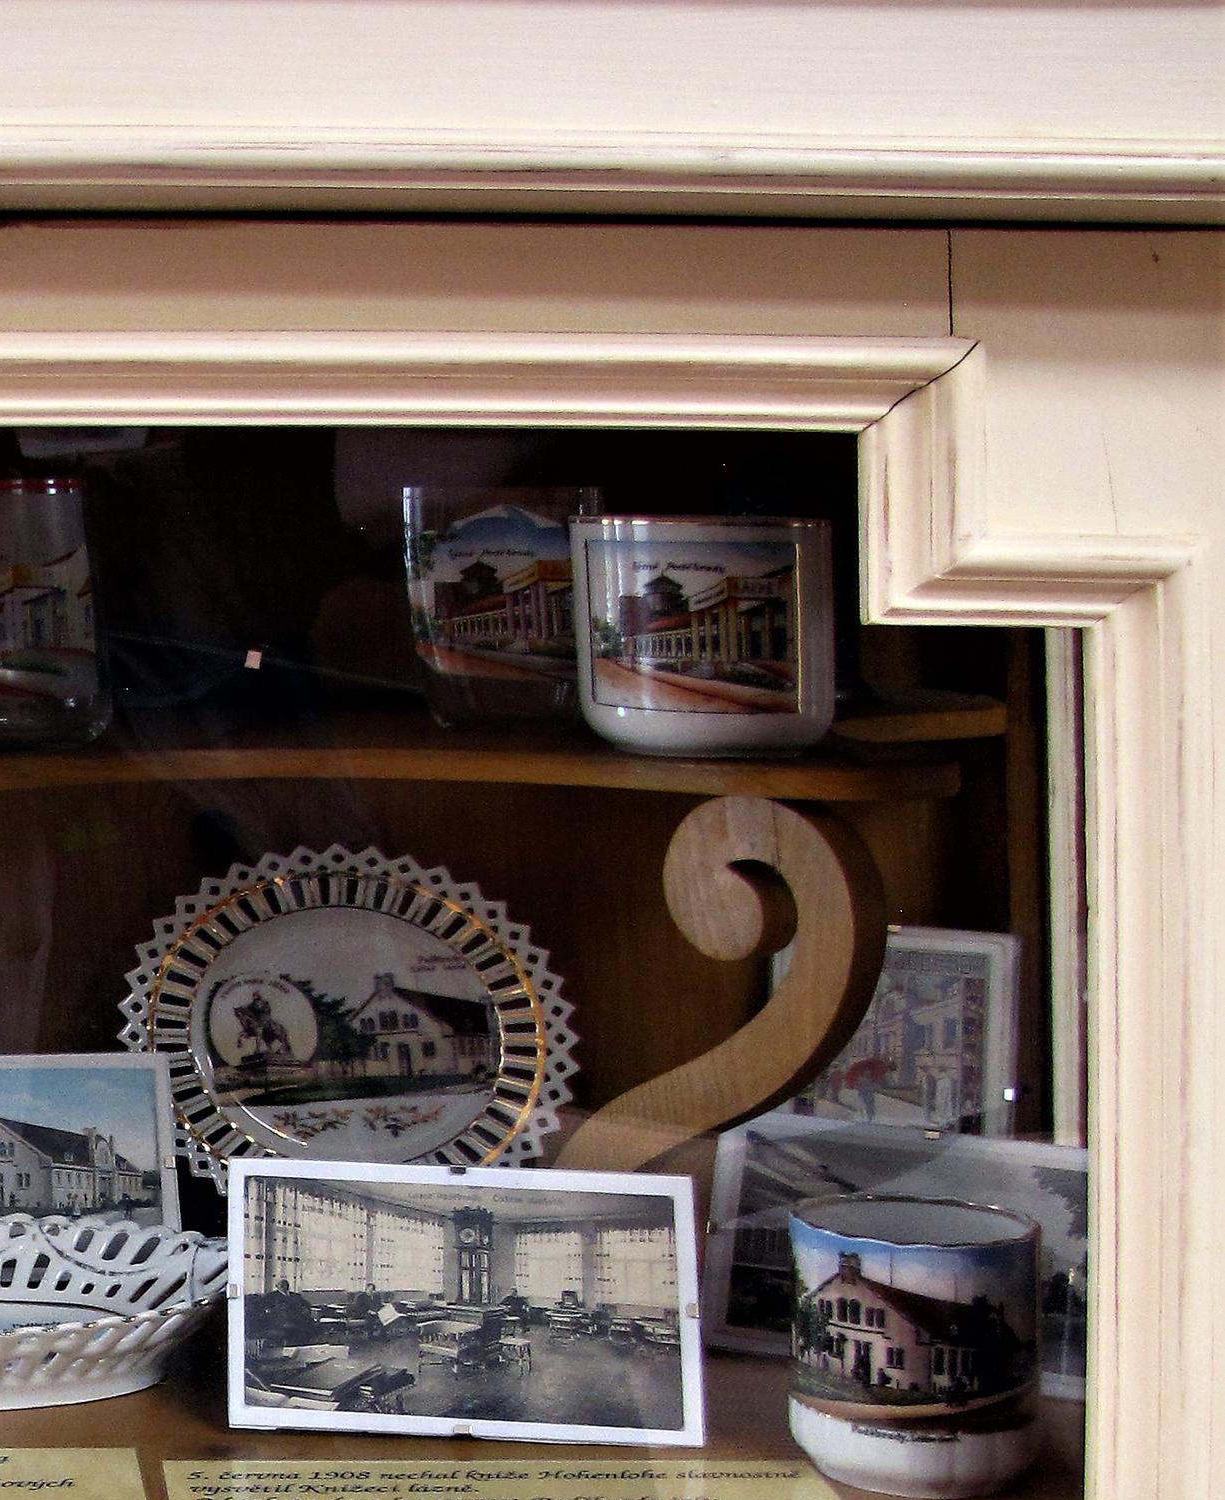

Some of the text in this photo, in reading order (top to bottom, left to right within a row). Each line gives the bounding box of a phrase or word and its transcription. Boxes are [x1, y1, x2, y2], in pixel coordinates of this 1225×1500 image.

[186, 1471, 209, 1480] 5.
[219, 1471, 302, 1480] června
[308, 1471, 371, 1480] 1908
[380, 1470, 461, 1480] nechal
[538, 1470, 667, 1480] Hohenlohe
